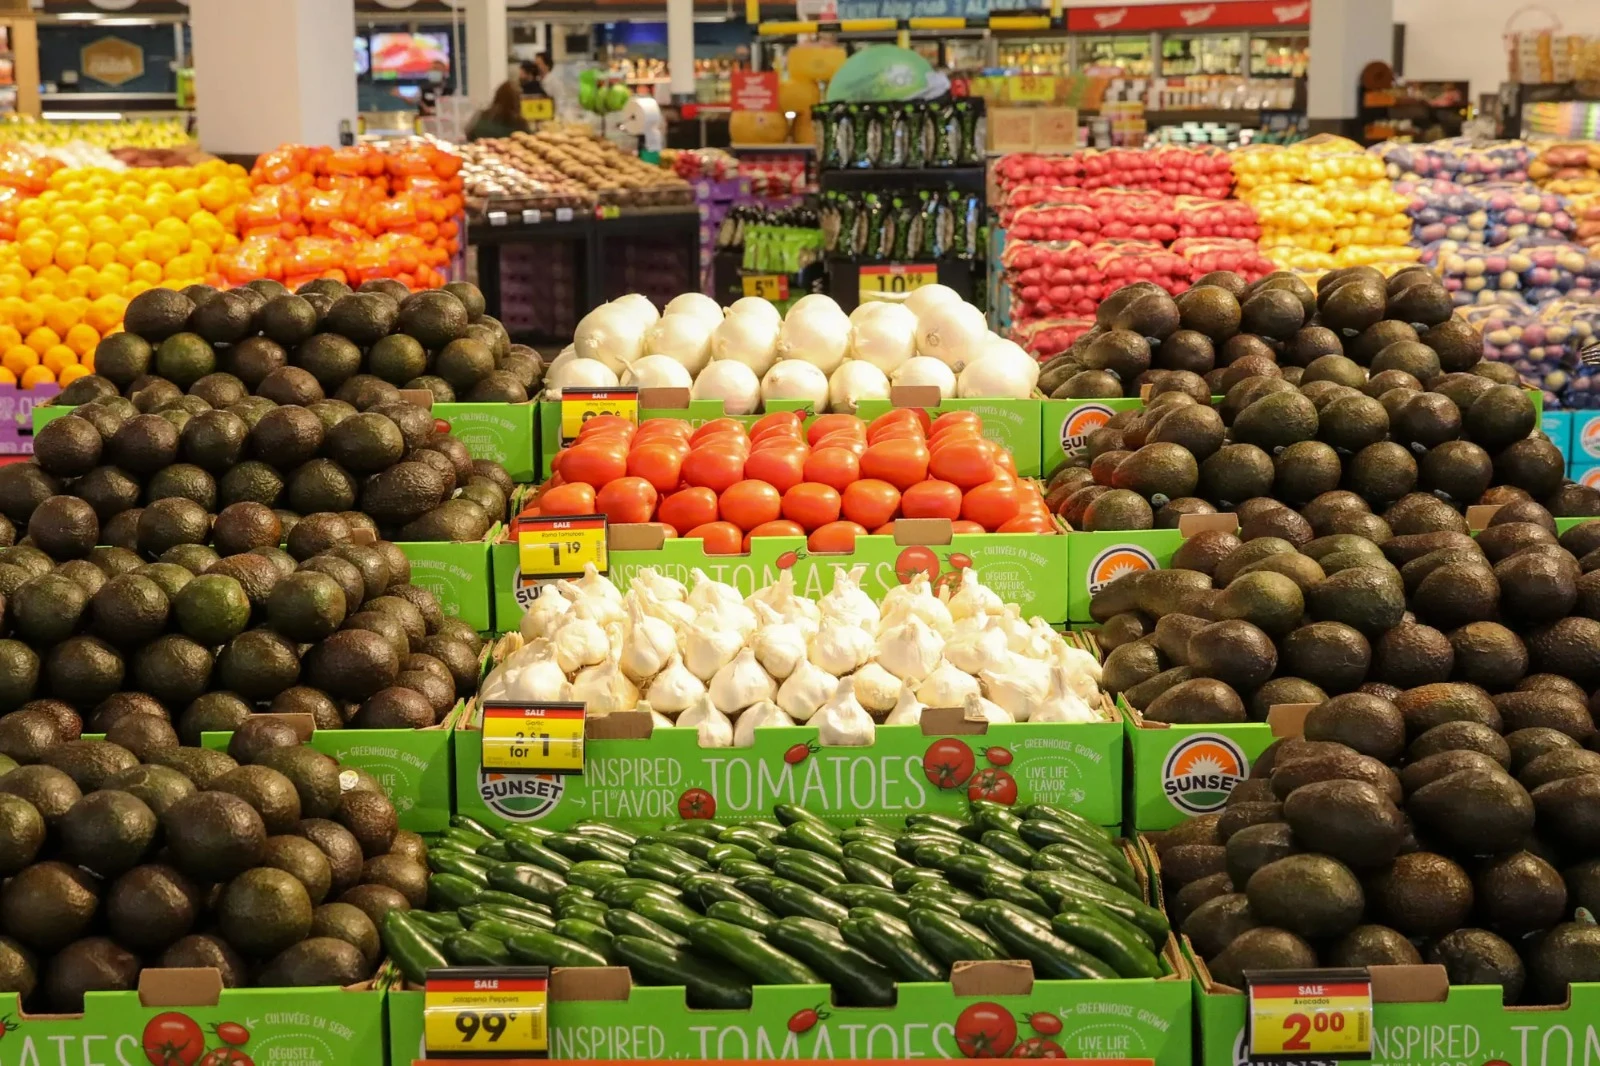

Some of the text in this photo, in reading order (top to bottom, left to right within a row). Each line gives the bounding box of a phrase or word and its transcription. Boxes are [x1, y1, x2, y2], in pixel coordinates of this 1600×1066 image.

[984, 545, 1016, 556] CULTIVÉES
[1018, 548, 1028, 558] EN
[409, 559, 473, 582] REENHOUSE GROWN
[350, 746, 429, 772] GREENHOUSE GROWN
[510, 746, 529, 758] for
[1025, 738, 1103, 764] GREENHOUSE GROWN
[584, 757, 682, 788] INSPIRED
[1025, 766, 1069, 779] LIVE LIFE
[481, 780, 563, 800] SUNSET
[701, 755, 926, 812] TOMATOES
[1029, 779, 1066, 792] FLAVOR
[1164, 774, 1245, 796] SUNSE
[592, 788, 676, 818] FLAVOR
[474, 980, 499, 989] SALE
[1298, 985, 1324, 995] SALE
[265, 1012, 310, 1026] CULTIVÉES
[313, 1015, 327, 1029] EN
[1076, 1002, 1170, 1032] GREENHOUSE GROWN
[548, 1025, 665, 1060] INSPIRED
[1078, 1035, 1130, 1050] LIVE LIFE
[1371, 1024, 1480, 1060] NSPIRED
[269, 1046, 315, 1060] DÉGUSTEZ
